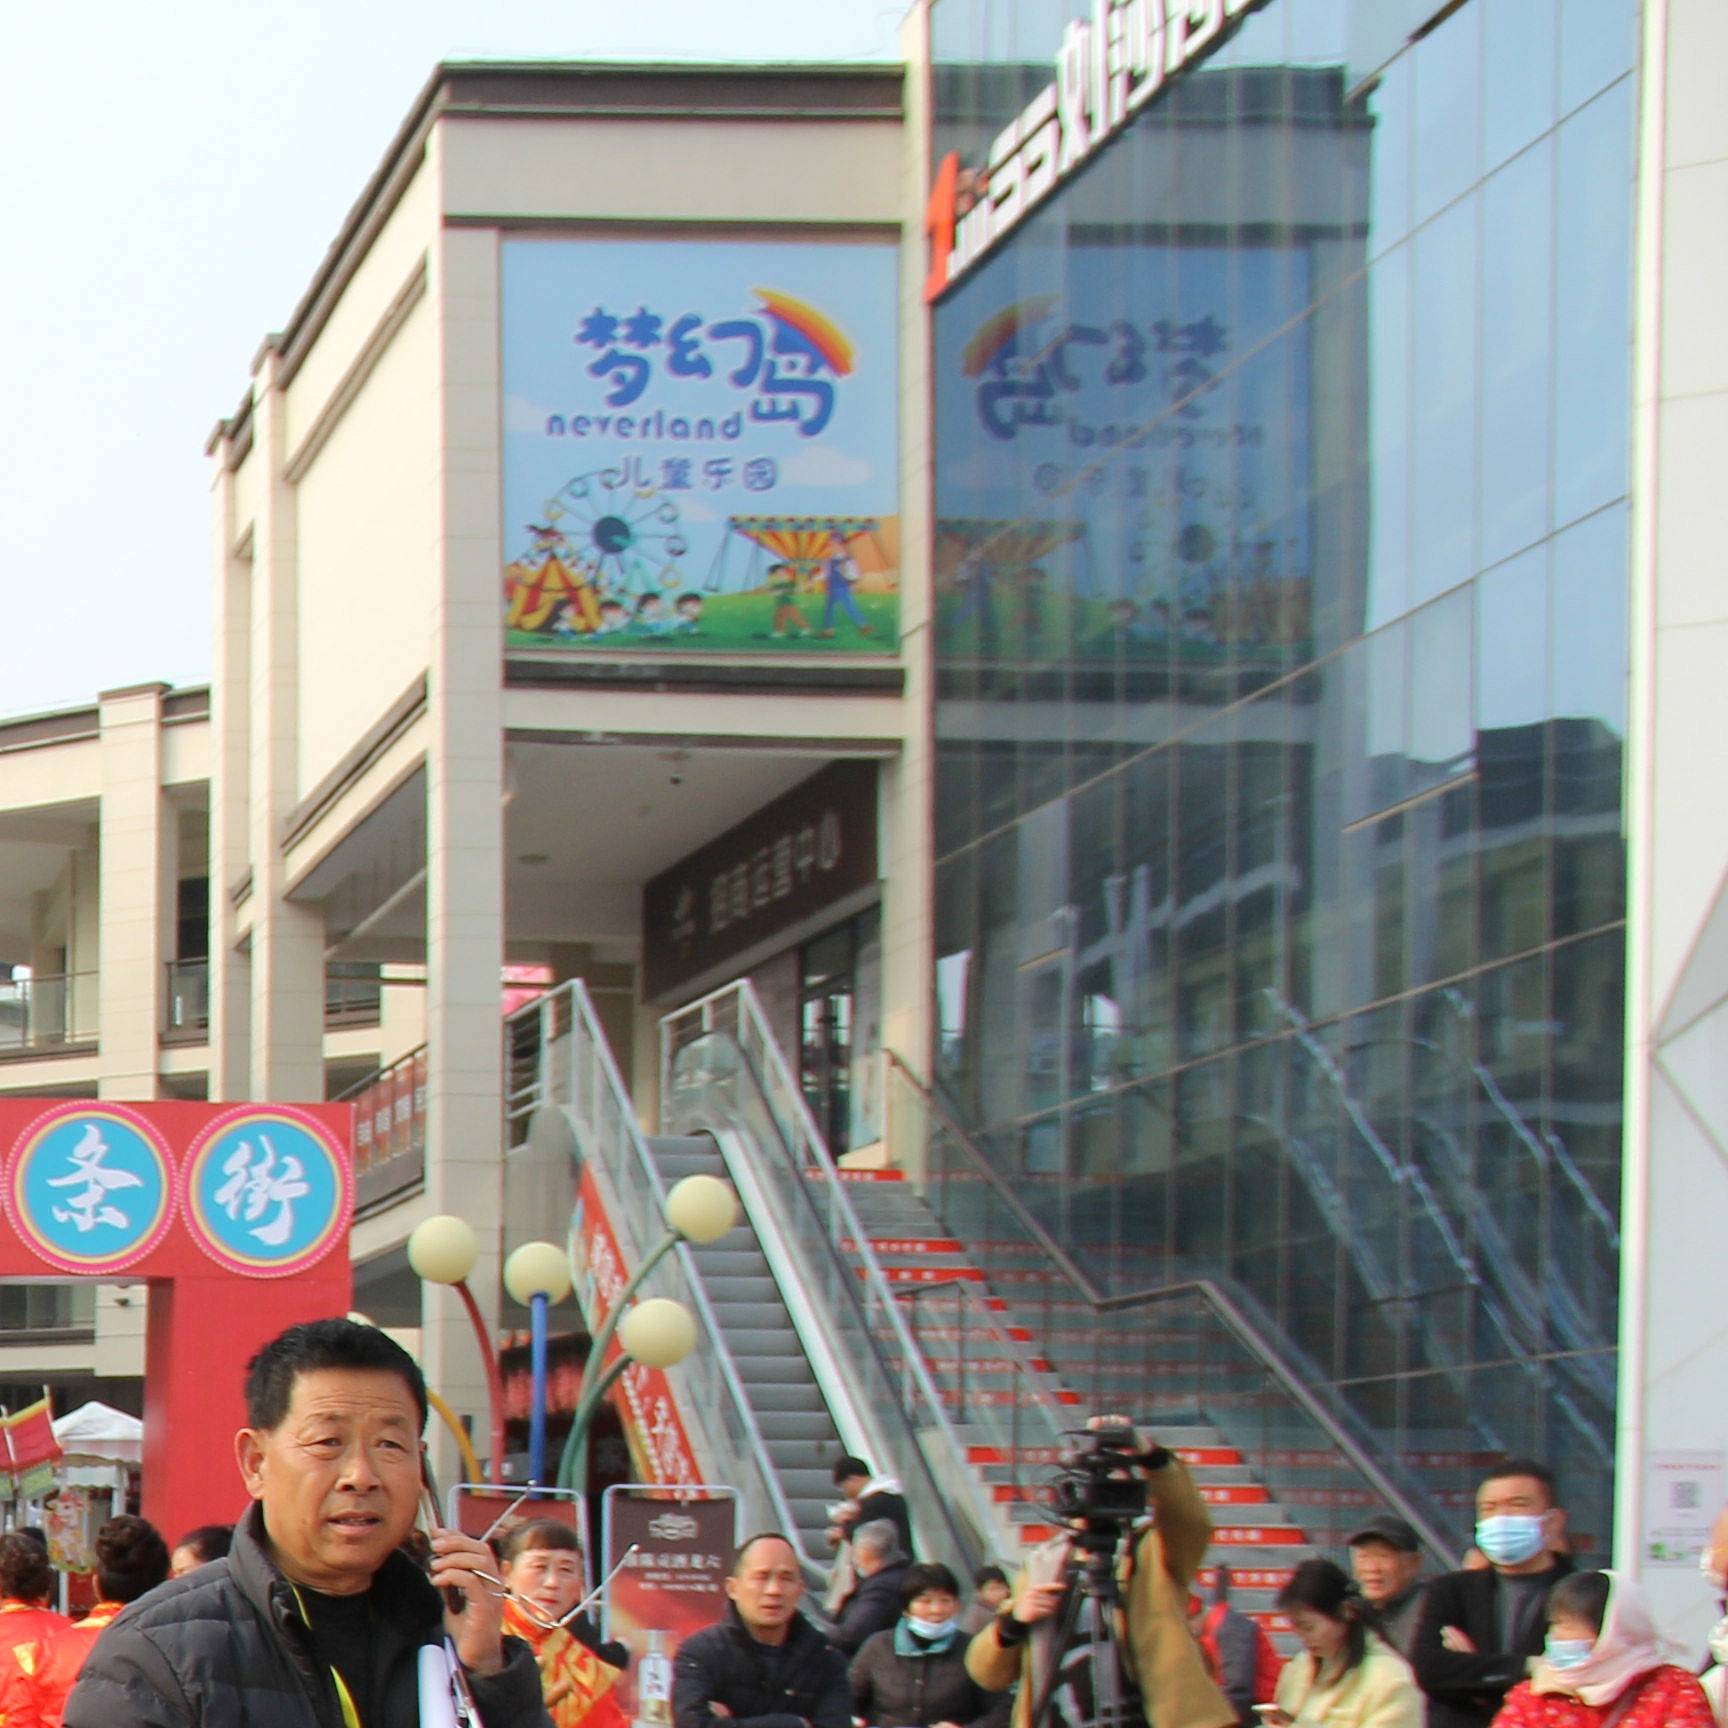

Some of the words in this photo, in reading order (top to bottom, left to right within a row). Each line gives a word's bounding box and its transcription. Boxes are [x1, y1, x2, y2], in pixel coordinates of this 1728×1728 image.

[574, 306, 836, 438] 梦幻岛
[546, 409, 743, 441] neverland
[618, 456, 778, 492] 儿童乐园
